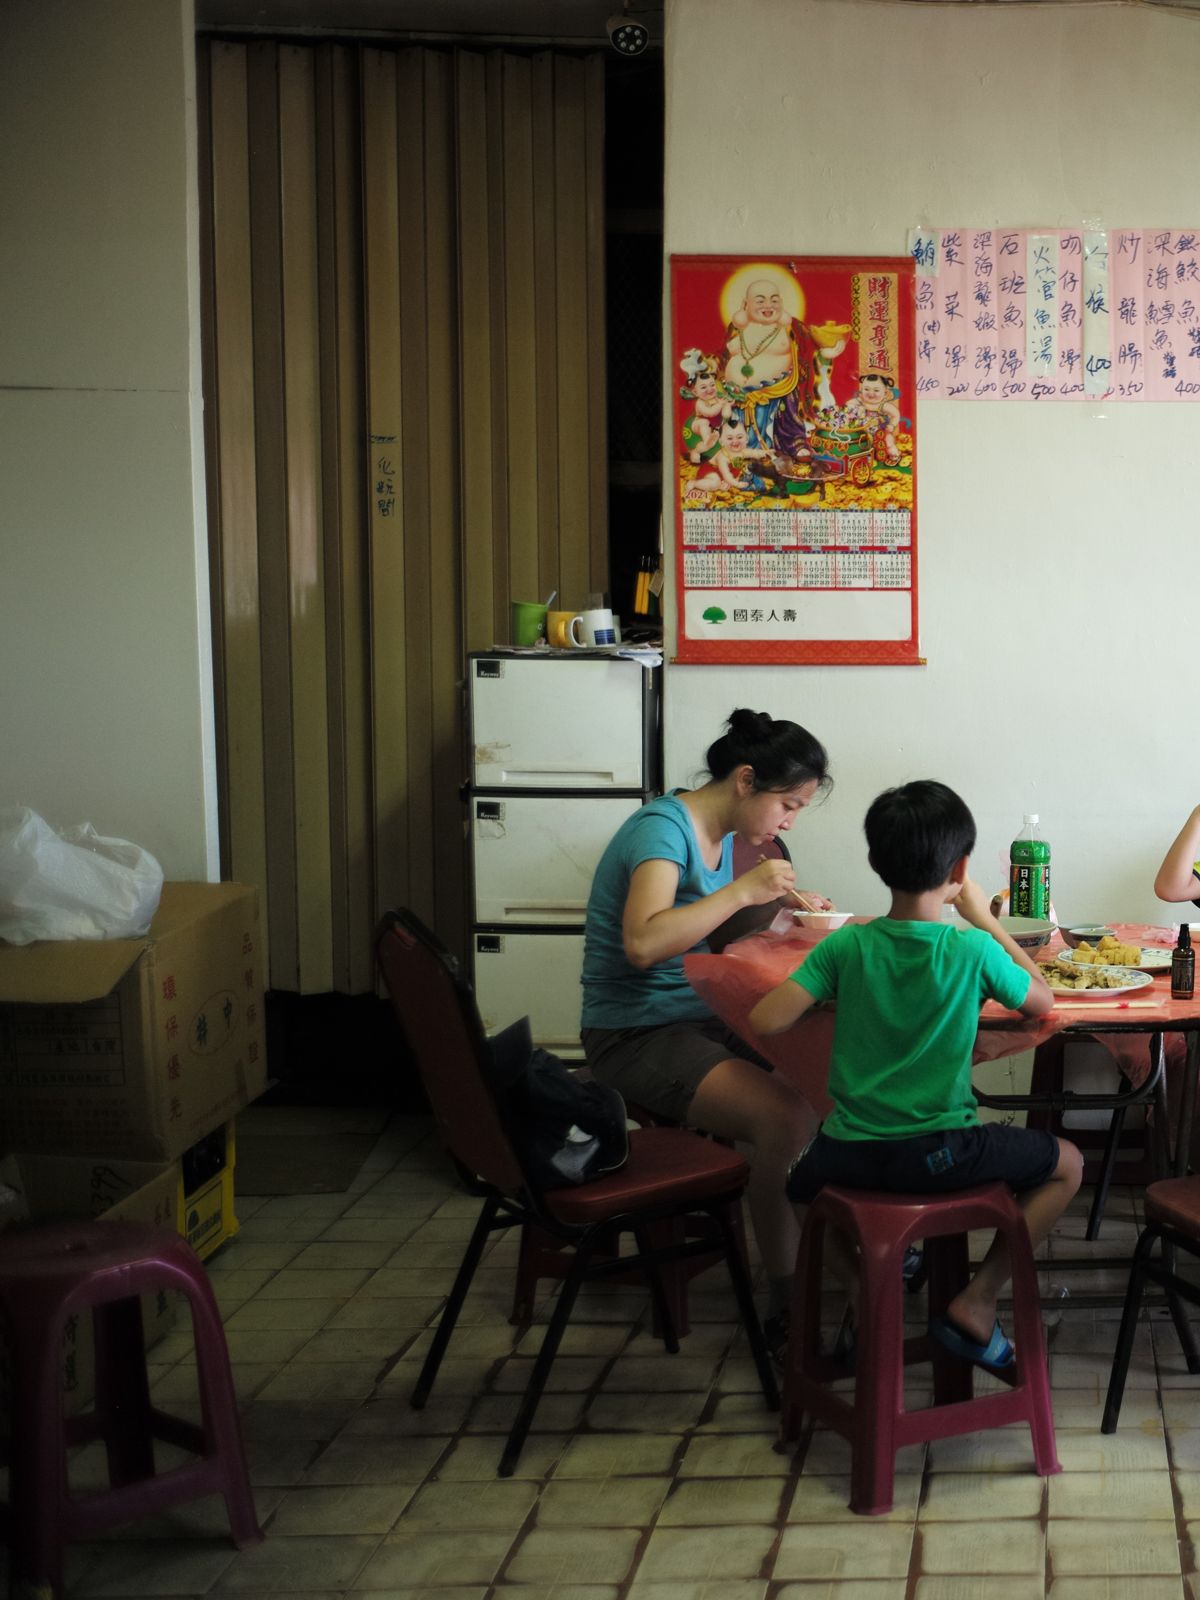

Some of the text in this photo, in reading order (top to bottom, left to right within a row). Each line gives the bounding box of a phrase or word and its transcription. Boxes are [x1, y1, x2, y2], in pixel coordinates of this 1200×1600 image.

[868, 276, 893, 373] 財運亨通
[1086, 355, 1111, 376] 400
[1001, 381, 1026, 398] 500
[1031, 383, 1056, 399] 500
[1119, 382, 1143, 396] 350
[1175, 380, 1200, 397] 400
[733, 609, 797, 623] 國泰人壽
